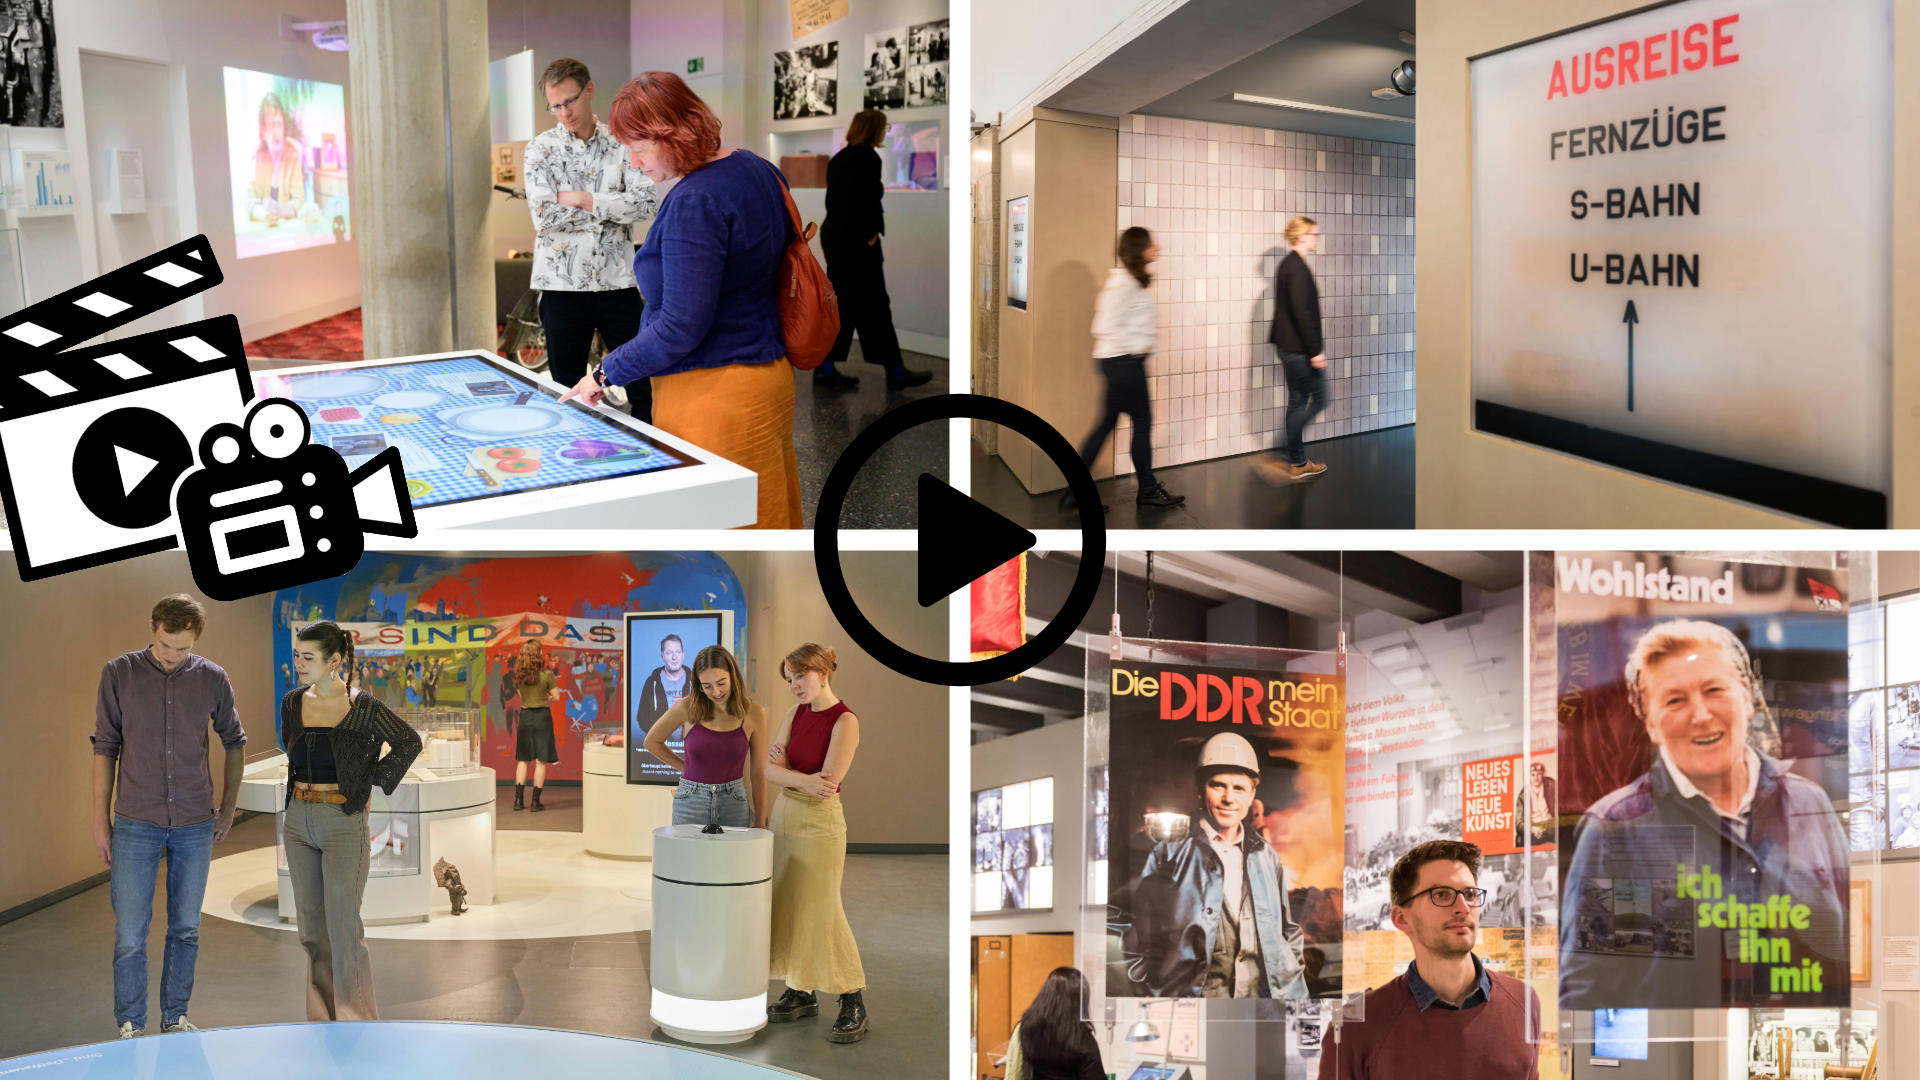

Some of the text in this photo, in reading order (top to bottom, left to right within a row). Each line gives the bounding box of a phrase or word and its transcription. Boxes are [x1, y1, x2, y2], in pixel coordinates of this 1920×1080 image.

[1546, 13, 1740, 100] AUSREISE
[1550, 105, 1727, 161] FERNZÜGE
[1570, 182, 1701, 220] S-BAHN
[1570, 252, 1701, 288] U-BAHN
[1557, 556, 1734, 605] Wohlstand
[1112, 668, 1338, 725] Die DDR mein
[1382, 706, 1415, 722] Wurzeln
[1268, 700, 1340, 729] Staat
[1466, 760, 1511, 781] NEUES
[1466, 777, 1508, 798] LEBEN
[1466, 796, 1502, 816] NEUE
[1466, 812, 1512, 833] KUNST
[1677, 863, 1722, 899] ich
[1698, 894, 1811, 930] schaffe
[1740, 929, 1791, 963] ihn
[1770, 958, 1823, 993] mit
